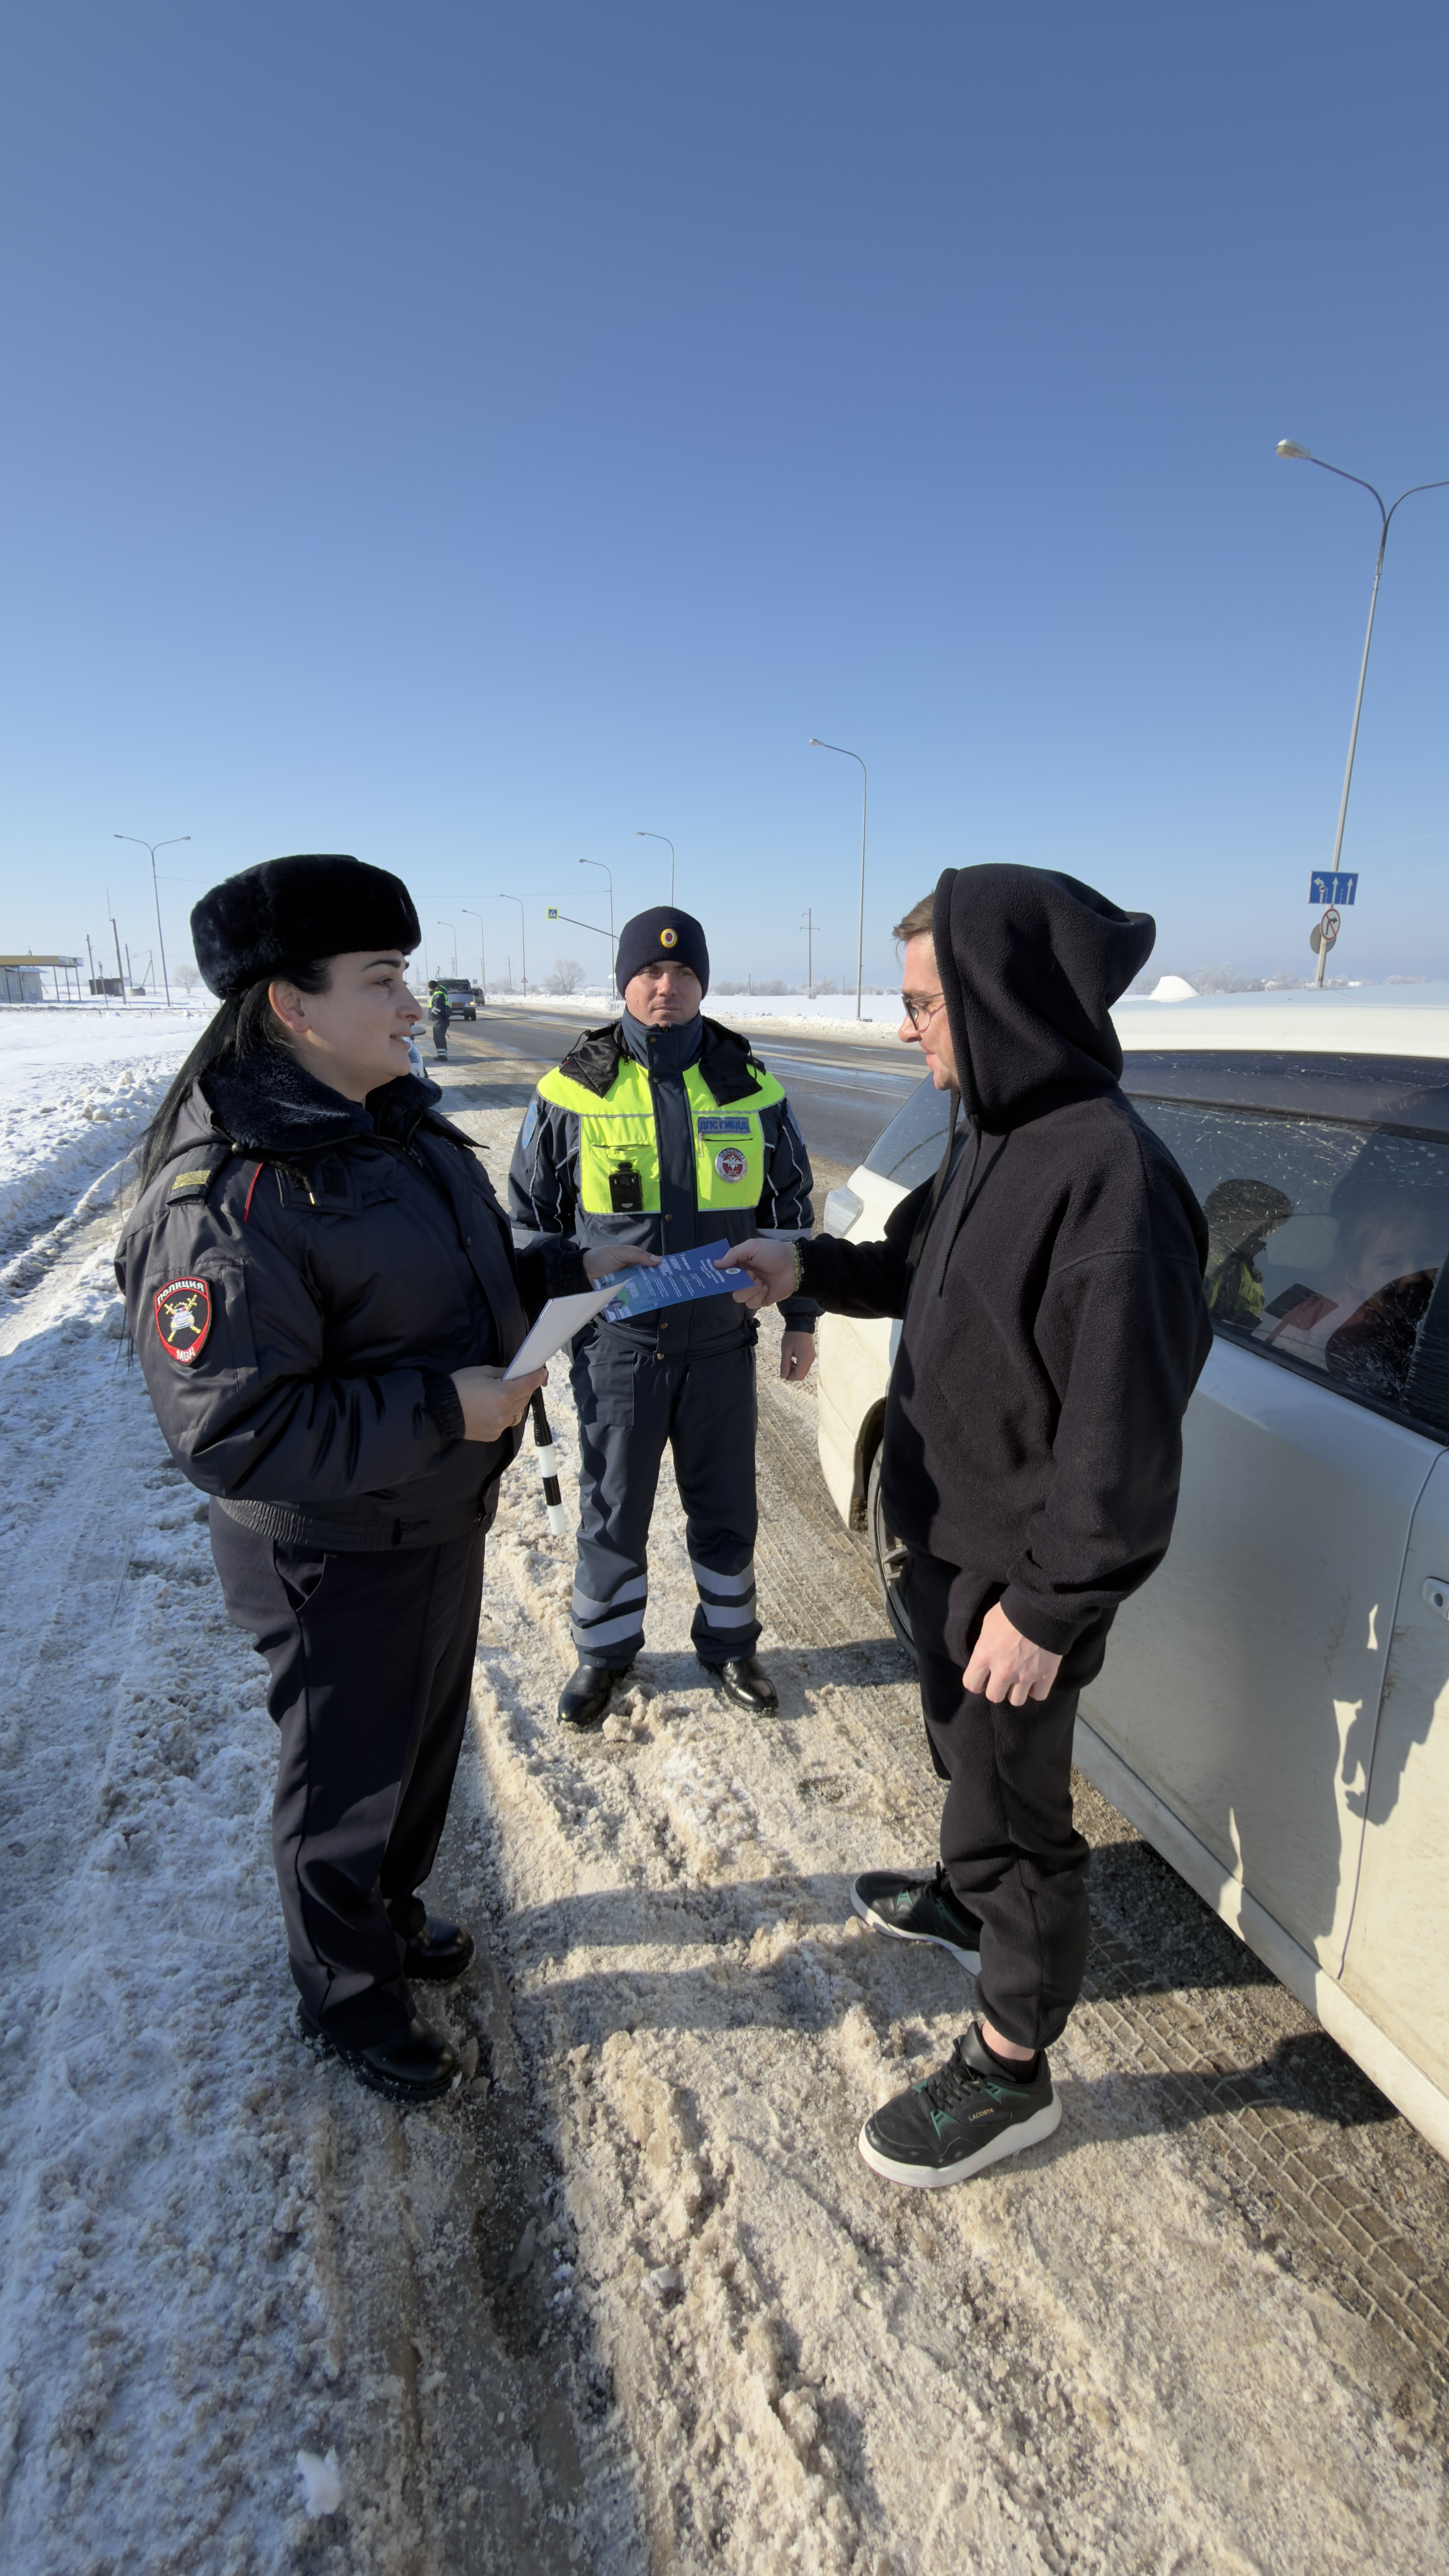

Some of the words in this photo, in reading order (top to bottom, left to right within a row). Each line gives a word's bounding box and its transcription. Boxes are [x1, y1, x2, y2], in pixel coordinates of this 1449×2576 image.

[700, 1121, 717, 1130] ДПС
[720, 1120, 747, 1130] ГИБДД
[720, 1148, 745, 1159] ПОЛИЦИЯ
[157, 1280, 204, 1306] ПОЛИЦИЯ
[968, 2107, 994, 2122] LACOSTE
